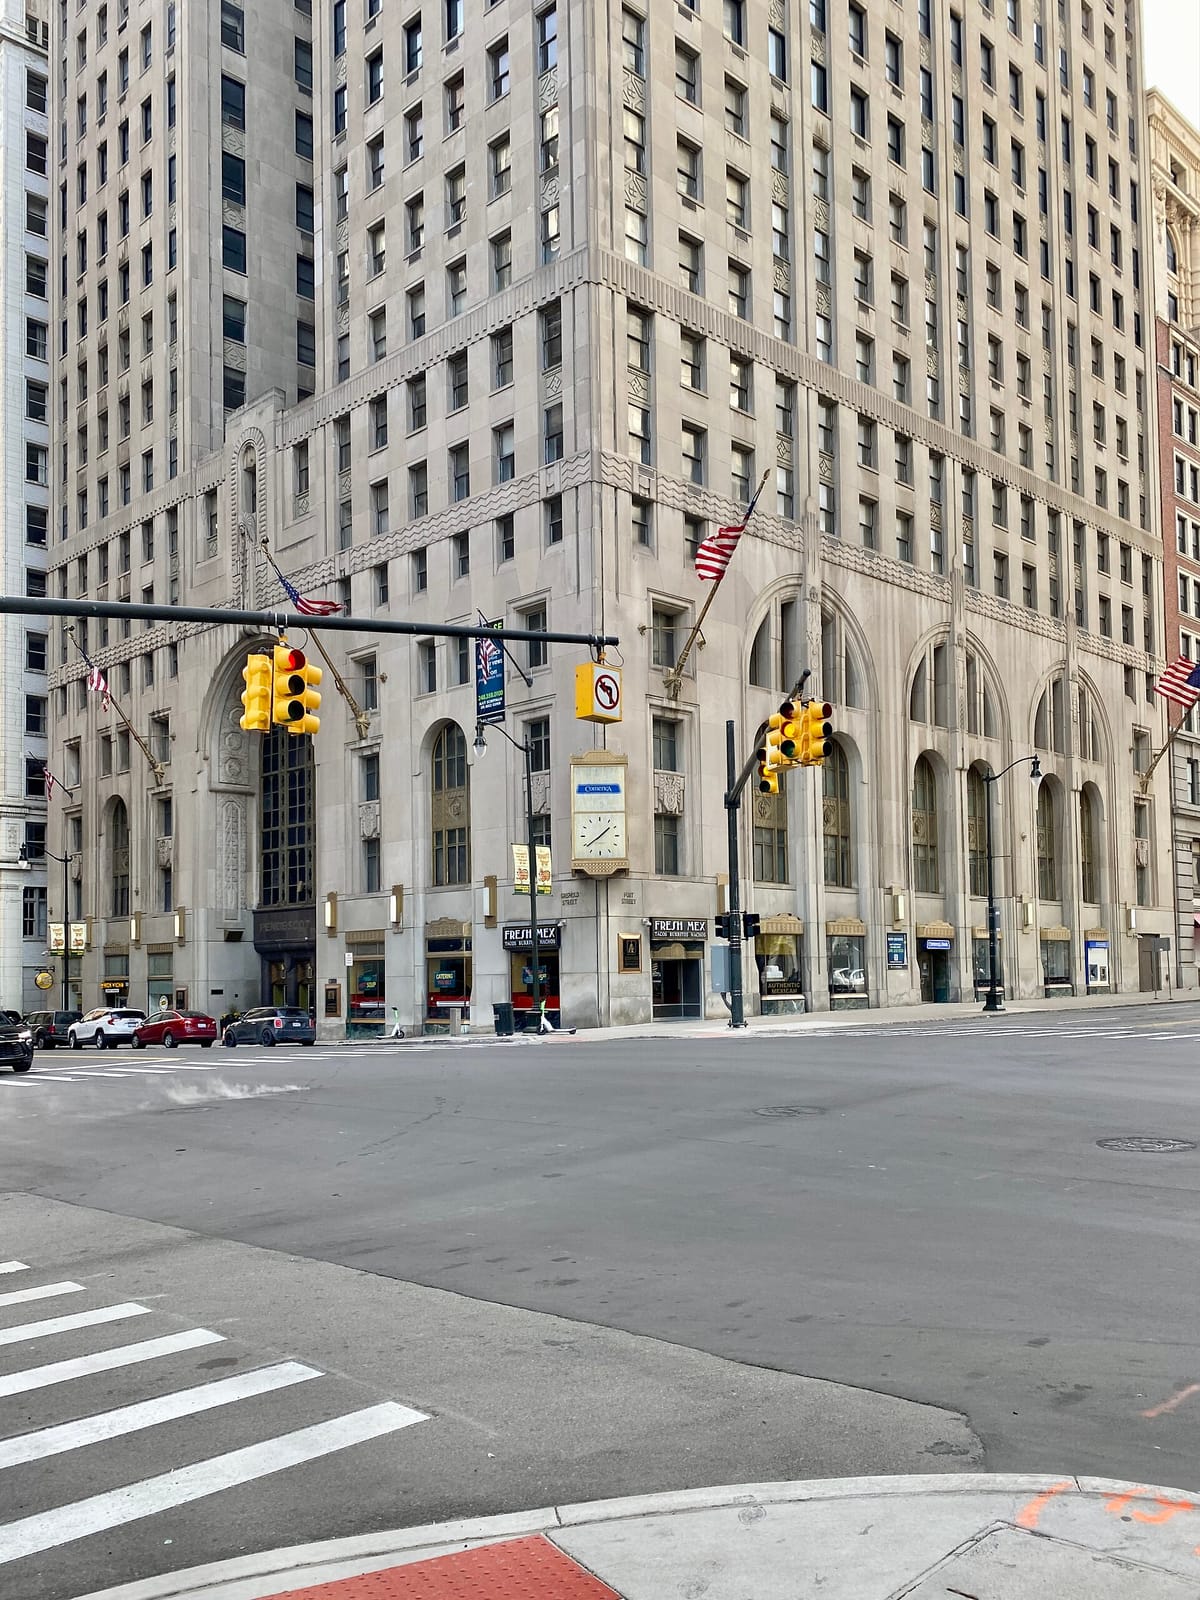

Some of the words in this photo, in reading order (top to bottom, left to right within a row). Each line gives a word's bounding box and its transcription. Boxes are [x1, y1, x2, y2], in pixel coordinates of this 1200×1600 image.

[654, 920, 683, 931] FRESH
[687, 920, 706, 931] MEX
[504, 928, 532, 940] FRESH
[536, 927, 556, 938] MEX
